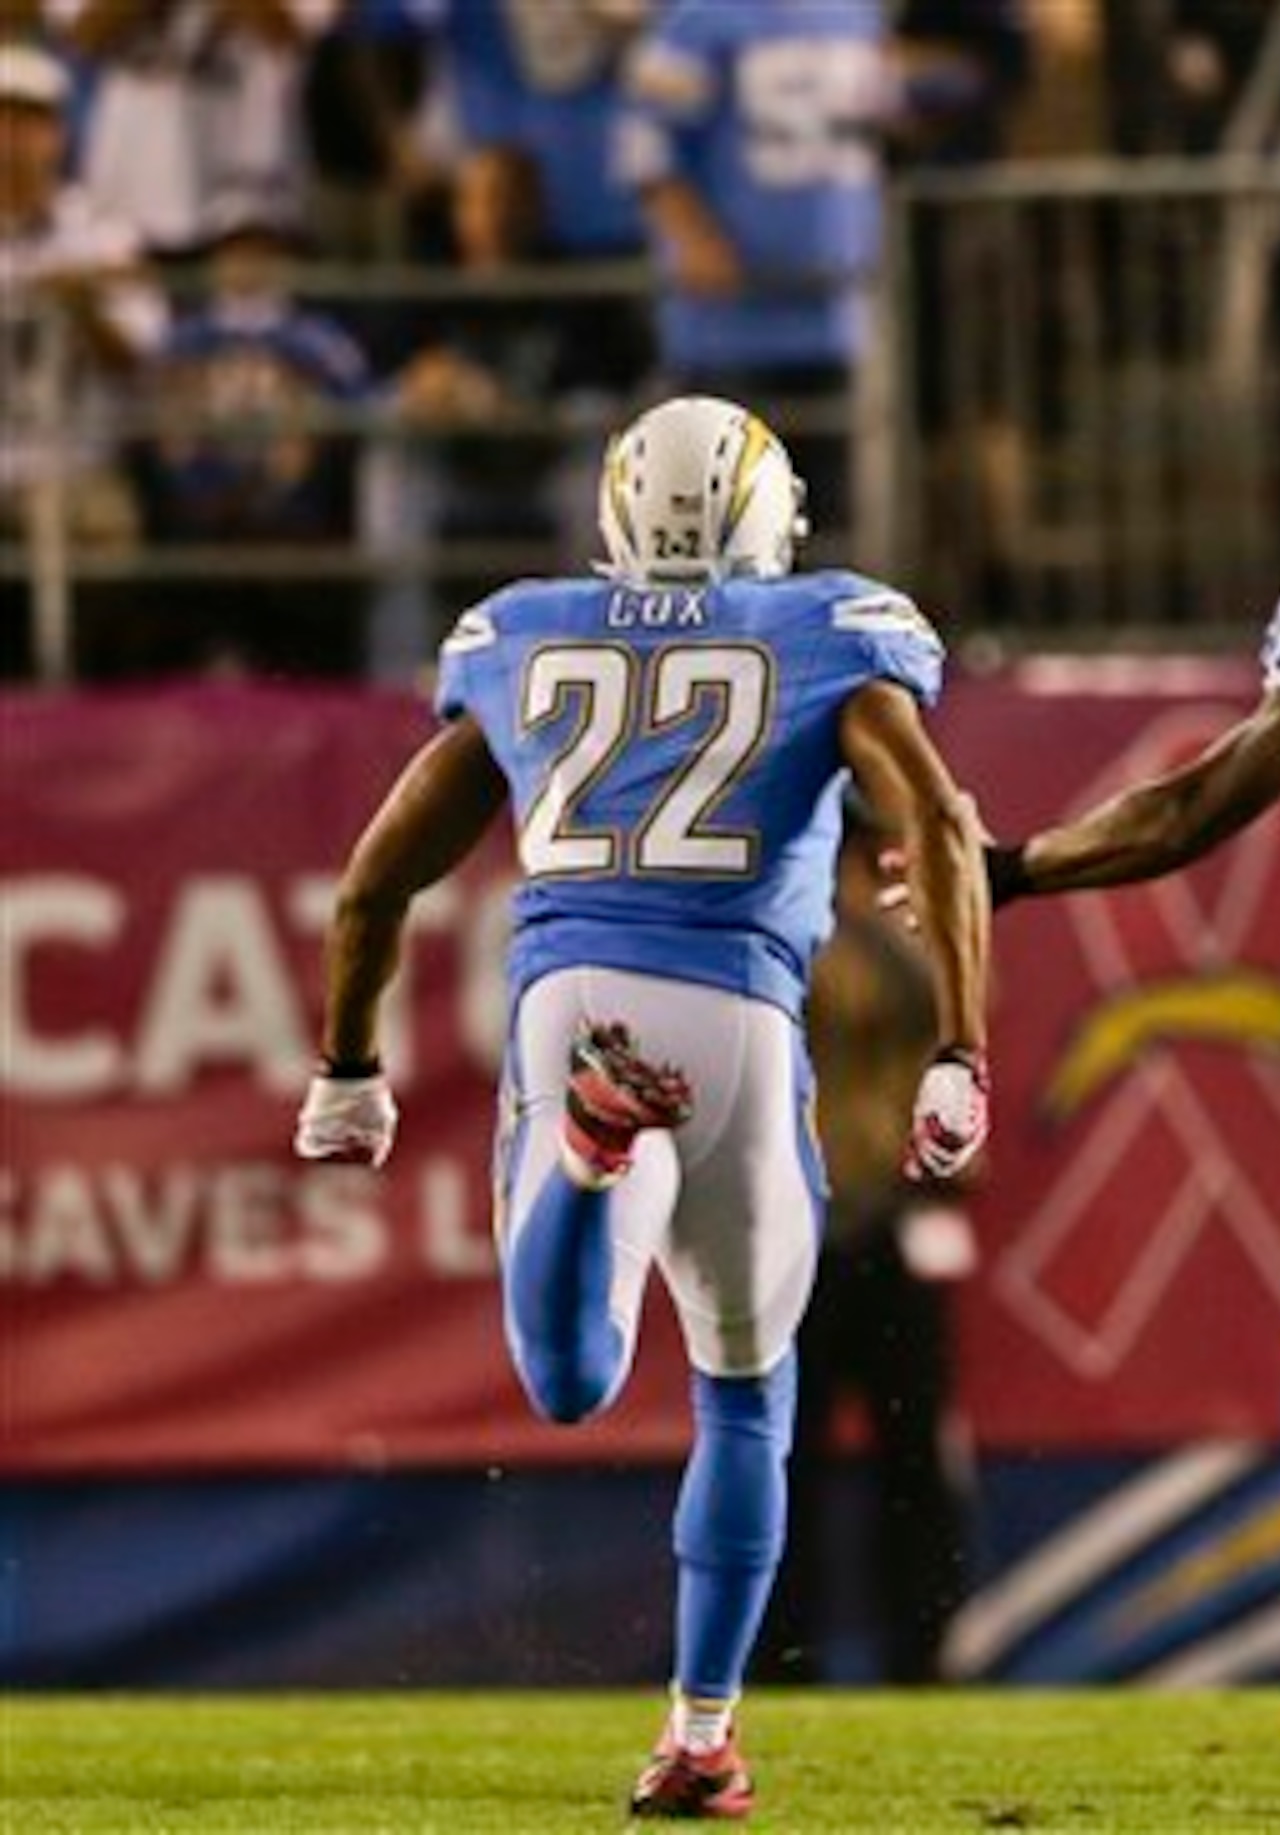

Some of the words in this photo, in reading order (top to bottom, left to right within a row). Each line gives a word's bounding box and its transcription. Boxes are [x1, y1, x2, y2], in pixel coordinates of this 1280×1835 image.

[608, 588, 706, 626] COX
[517, 640, 776, 880] 22
[0, 1158, 385, 1280] AVES
